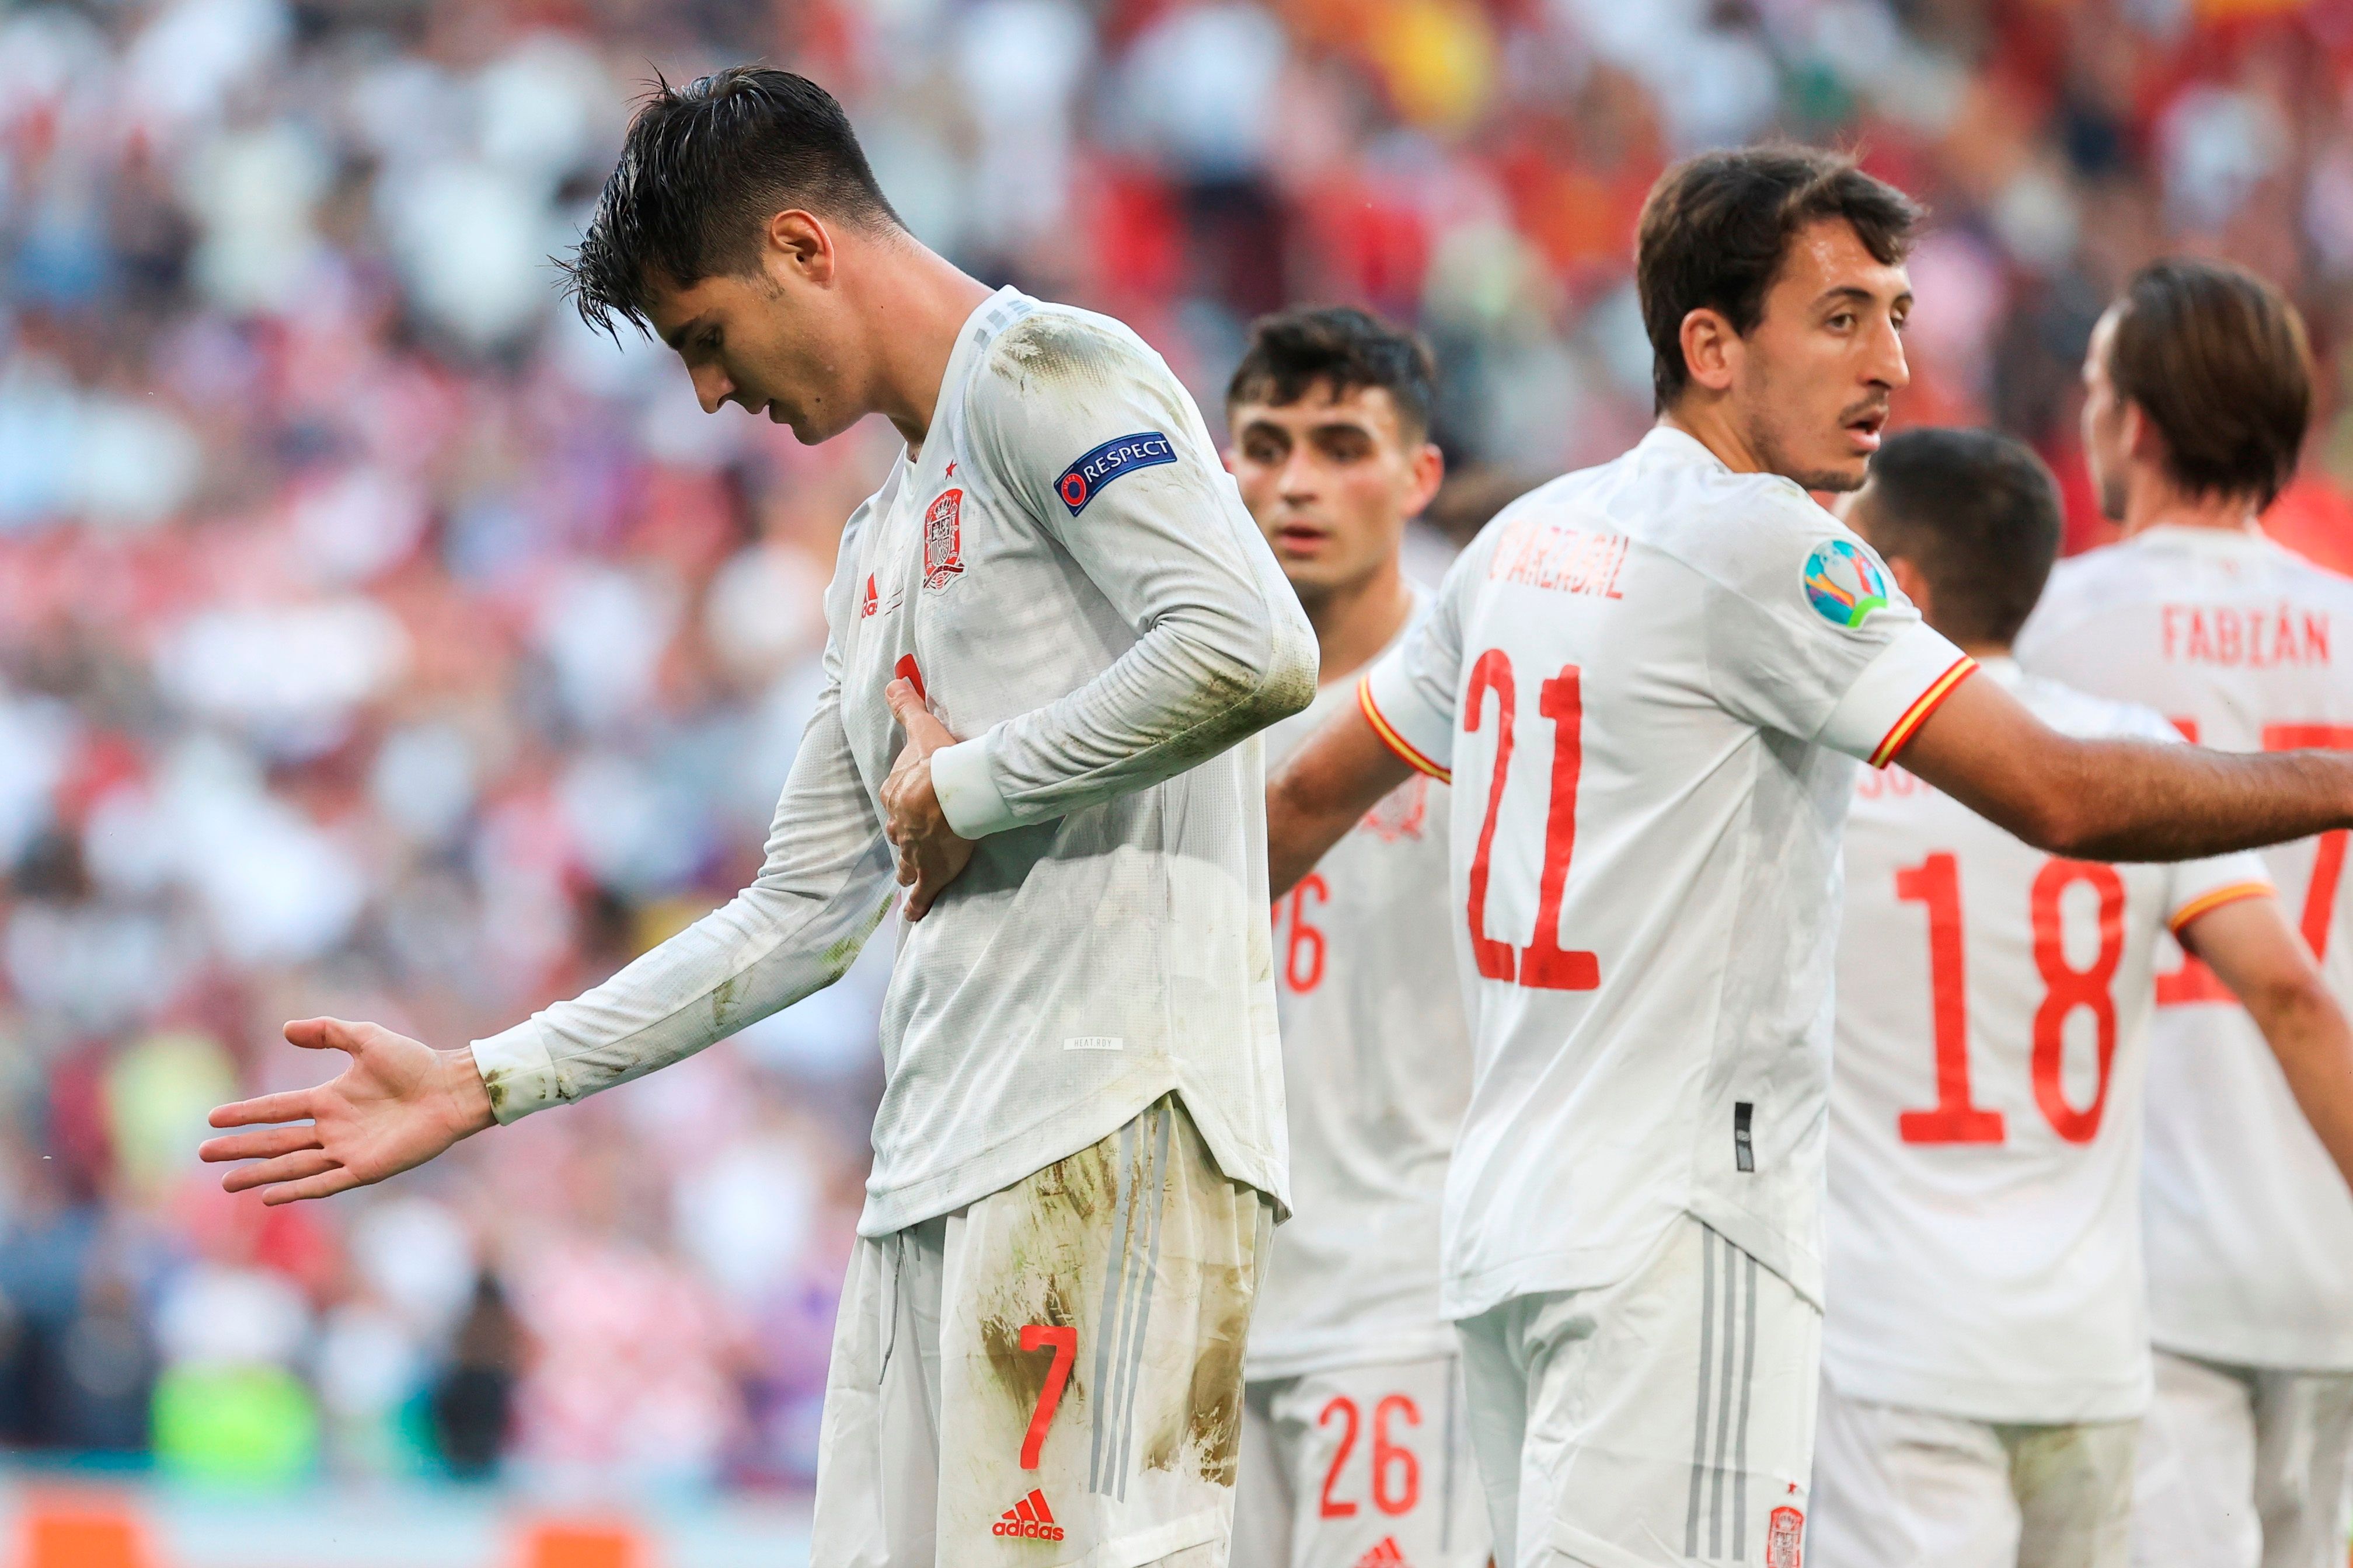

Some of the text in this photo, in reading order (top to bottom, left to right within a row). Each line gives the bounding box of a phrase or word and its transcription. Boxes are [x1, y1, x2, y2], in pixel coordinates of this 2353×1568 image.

[1083, 440, 1168, 483] RESPECT
[2161, 598, 2331, 669] FABIÁN
[1464, 649, 1601, 990] 21
[1895, 853, 2125, 1144] 18
[1020, 1325, 1077, 1469] 7
[1318, 1394, 1422, 1519] 26
[992, 1518, 1065, 1541] adidas
